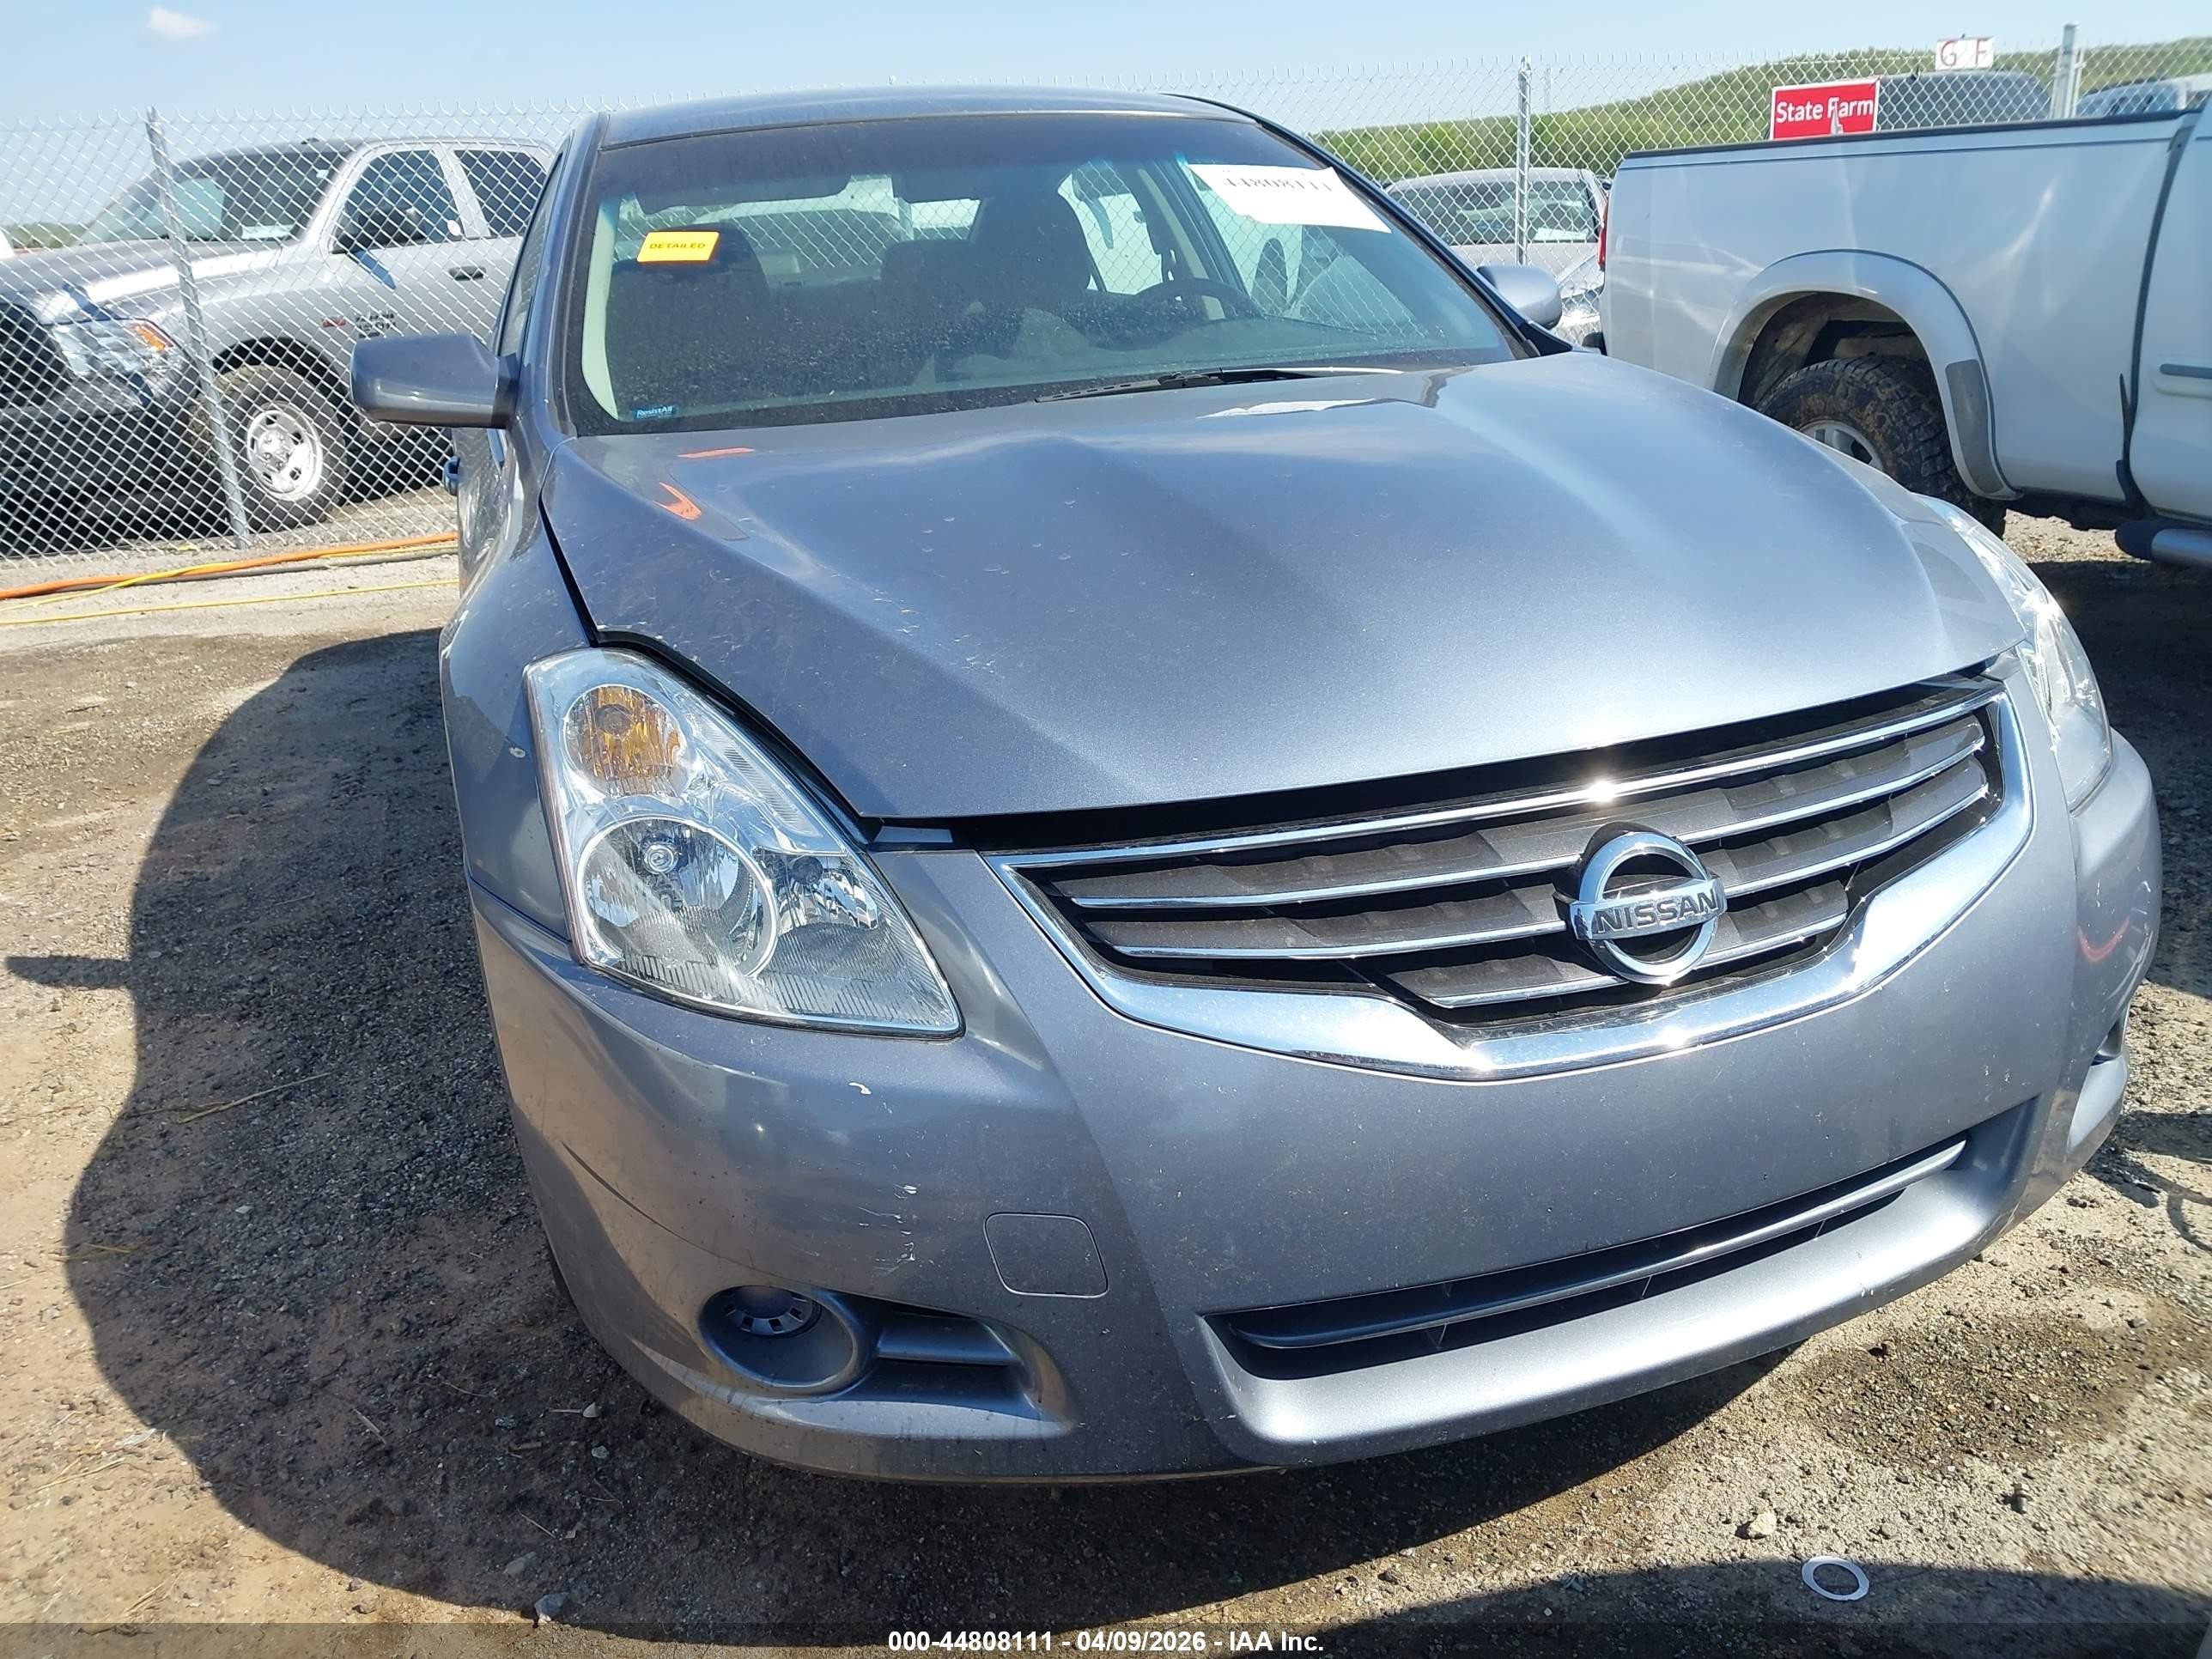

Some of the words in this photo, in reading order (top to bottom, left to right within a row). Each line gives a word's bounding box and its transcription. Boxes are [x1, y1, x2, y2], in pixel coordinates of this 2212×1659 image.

[1776, 100, 1824, 123] State
[1827, 96, 1874, 118] Farm
[1595, 888, 1718, 933] NISSAN
